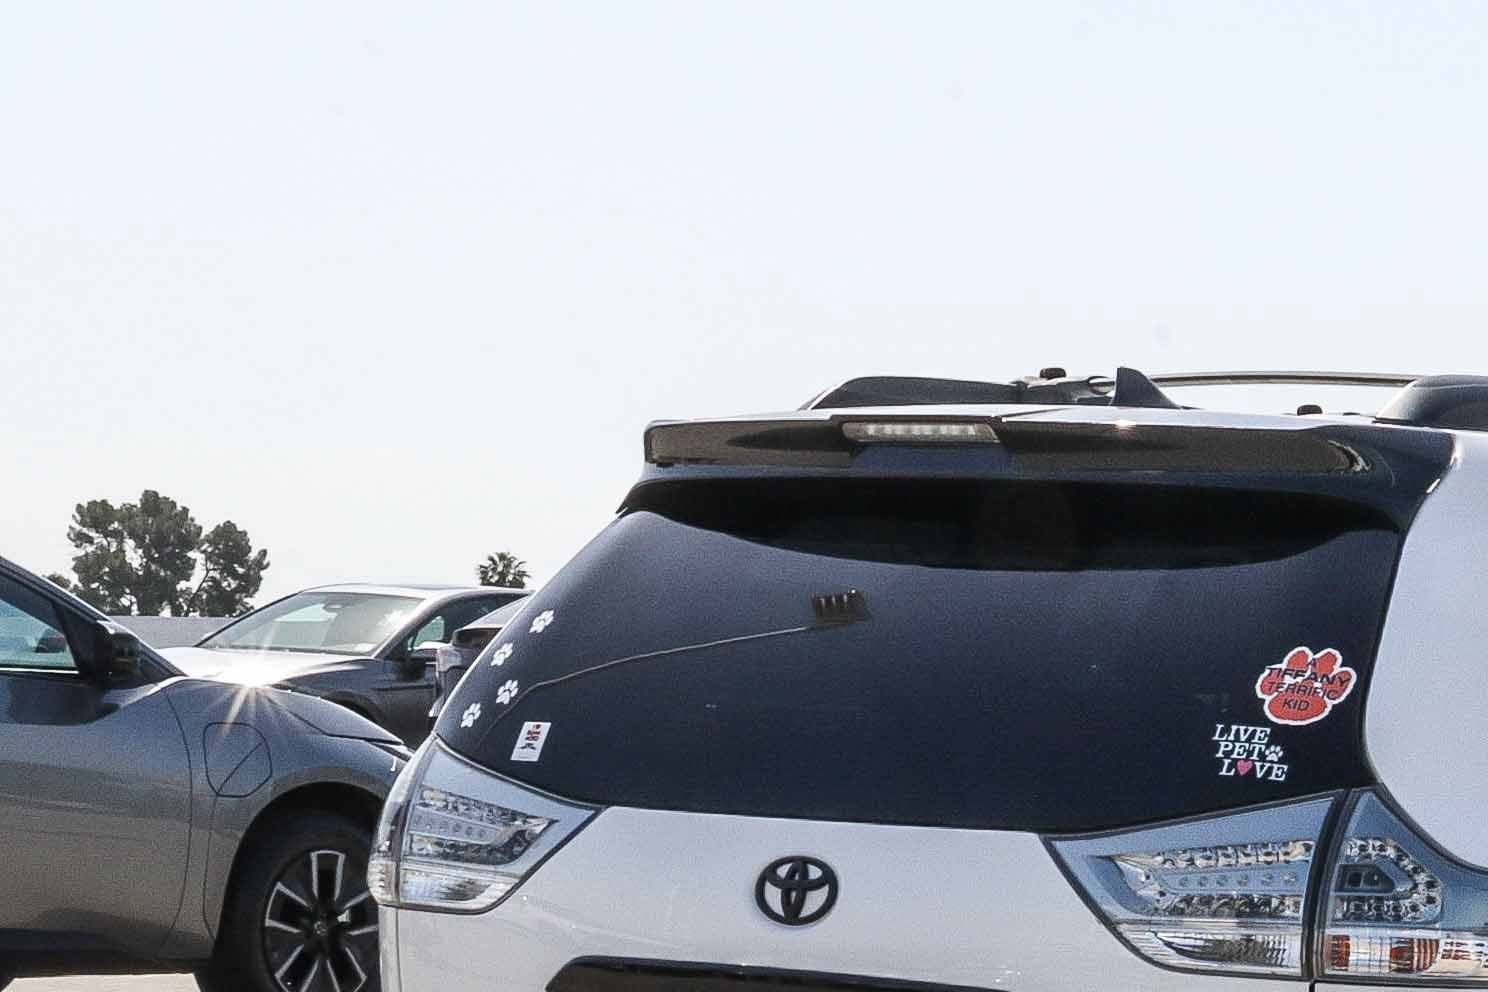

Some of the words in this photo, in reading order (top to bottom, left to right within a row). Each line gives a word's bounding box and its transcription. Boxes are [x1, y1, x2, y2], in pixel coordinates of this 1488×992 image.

[1266, 667, 1352, 687] TIFFANY
[1267, 682, 1340, 701] TERRIFIC
[1282, 699, 1310, 712] KID
[1212, 723, 1272, 744] LIVE
[1215, 741, 1265, 761] PET
